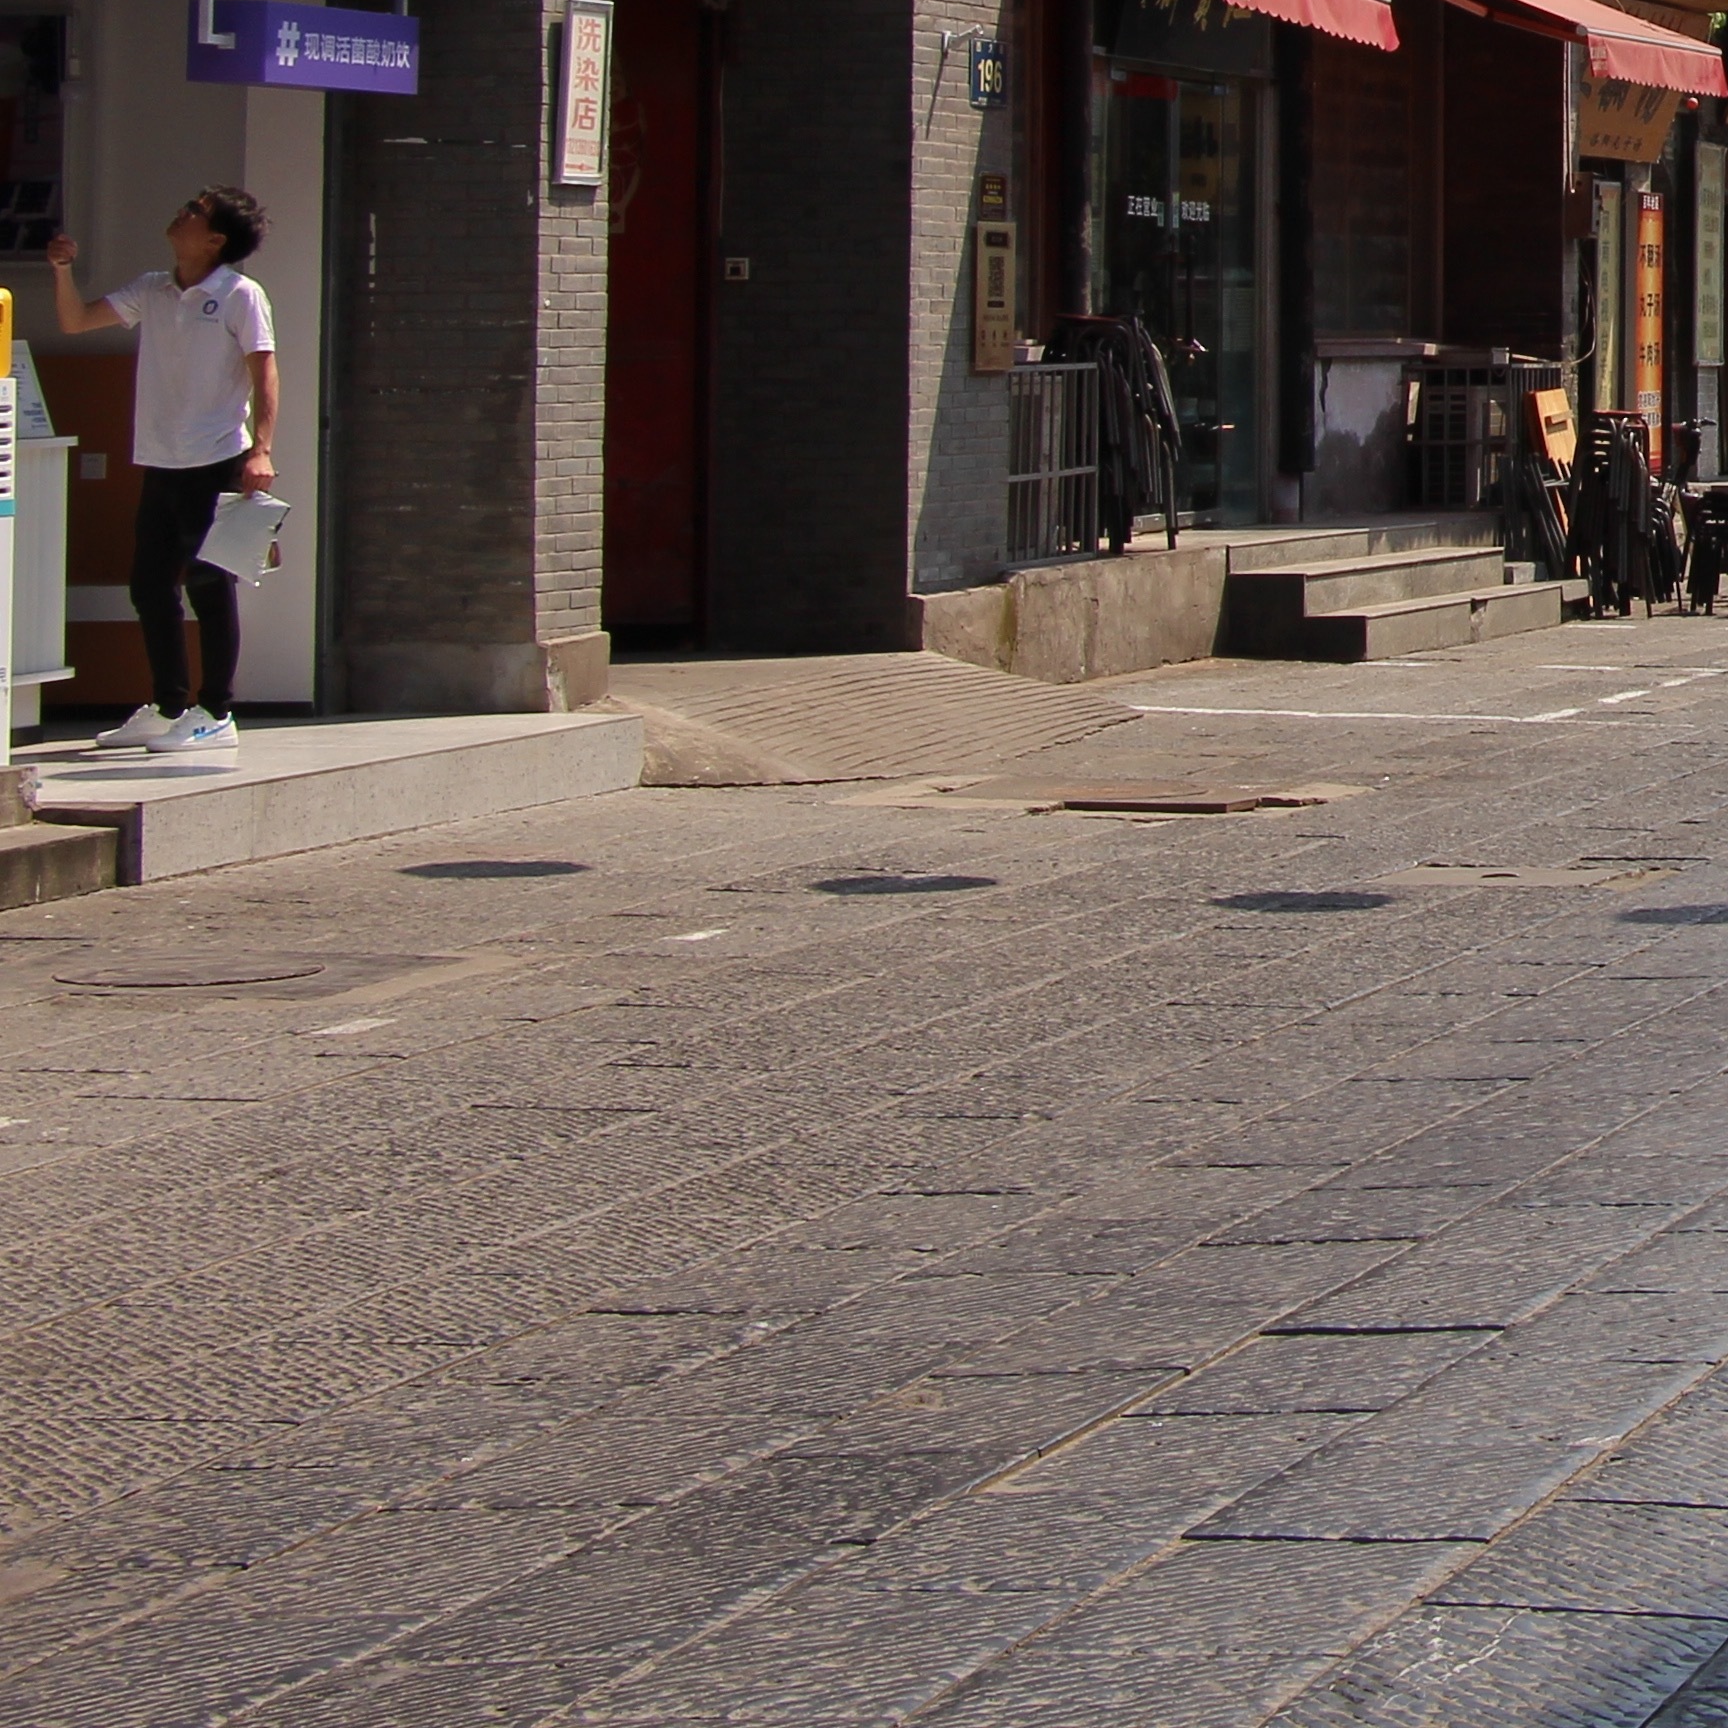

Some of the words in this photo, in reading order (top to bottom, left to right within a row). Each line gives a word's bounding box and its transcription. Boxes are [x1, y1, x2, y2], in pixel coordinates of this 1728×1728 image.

[572, 17, 601, 131] 洗染店
[977, 60, 1003, 94] 196
